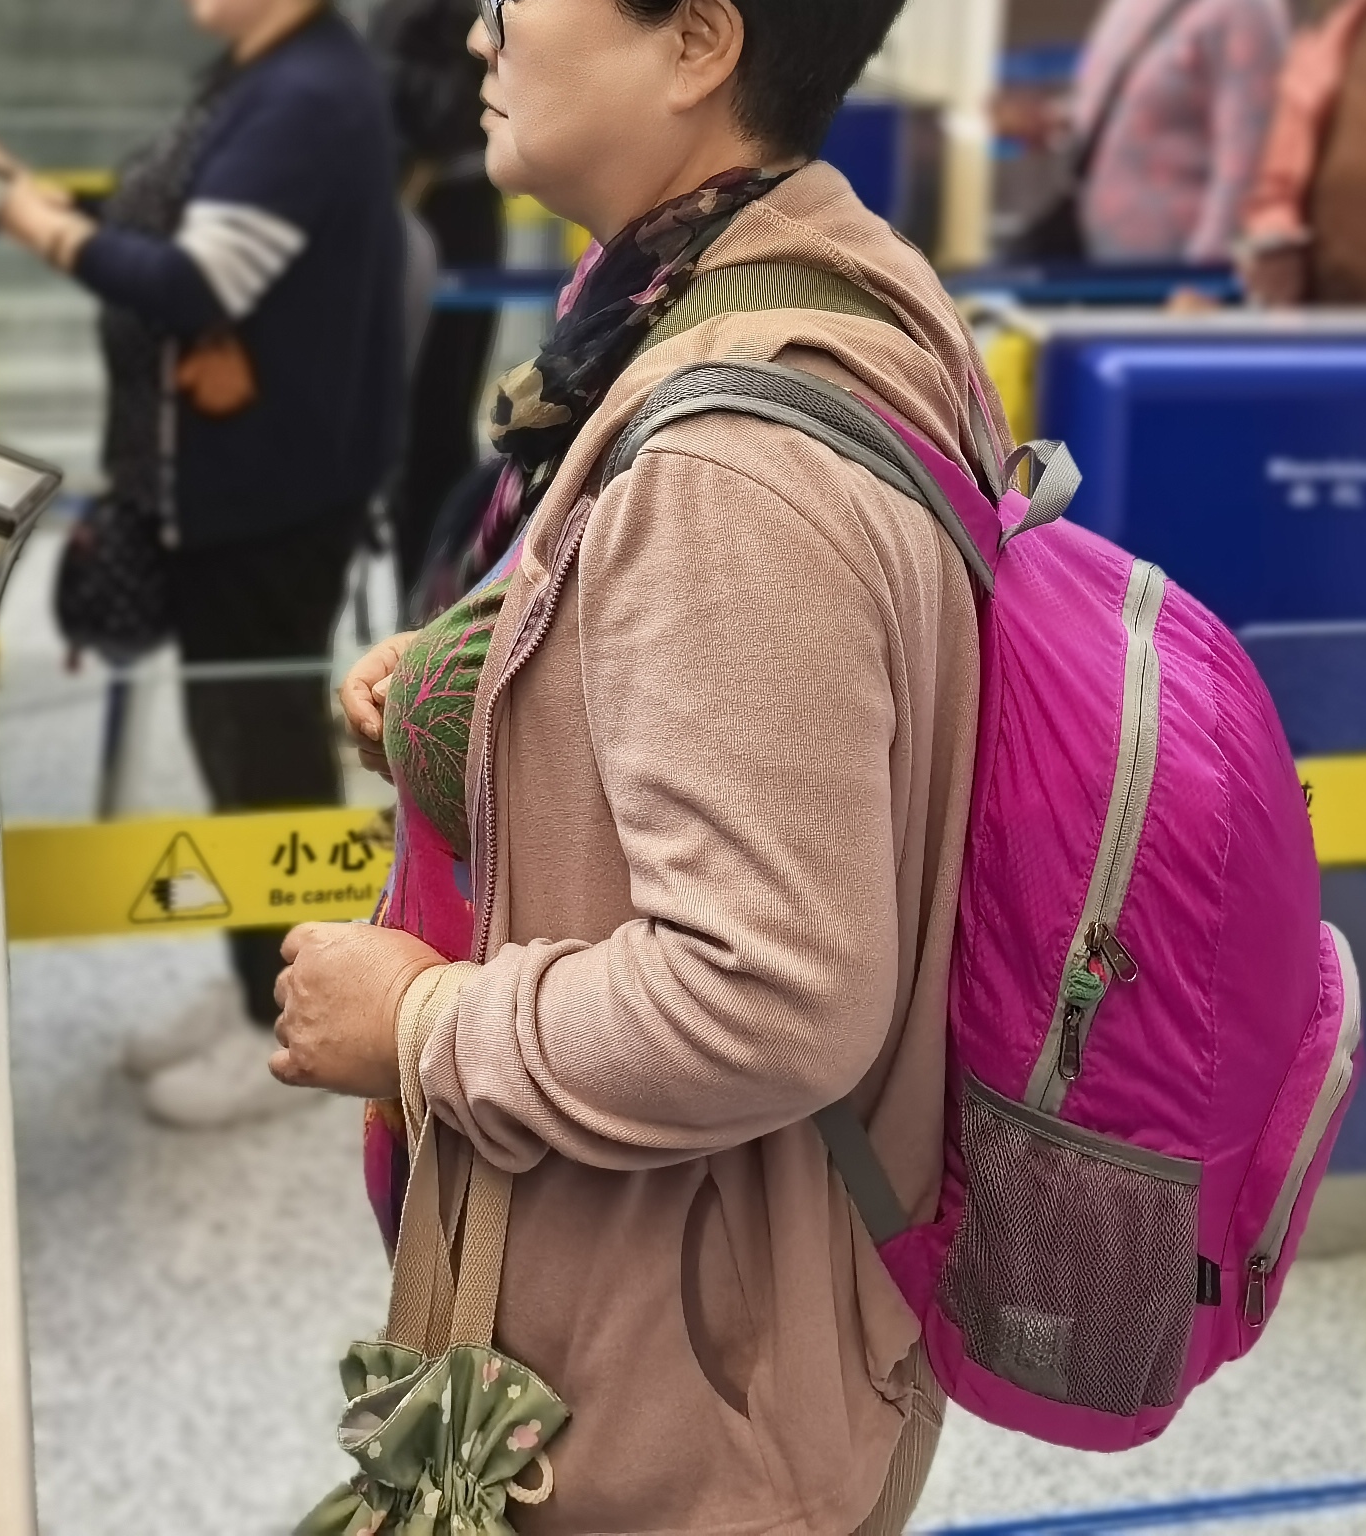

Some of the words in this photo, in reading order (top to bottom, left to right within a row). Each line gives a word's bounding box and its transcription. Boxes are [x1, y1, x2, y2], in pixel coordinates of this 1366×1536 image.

[270, 829, 375, 877] 小心
[268, 887, 297, 907] Be
[302, 883, 373, 905] careful
